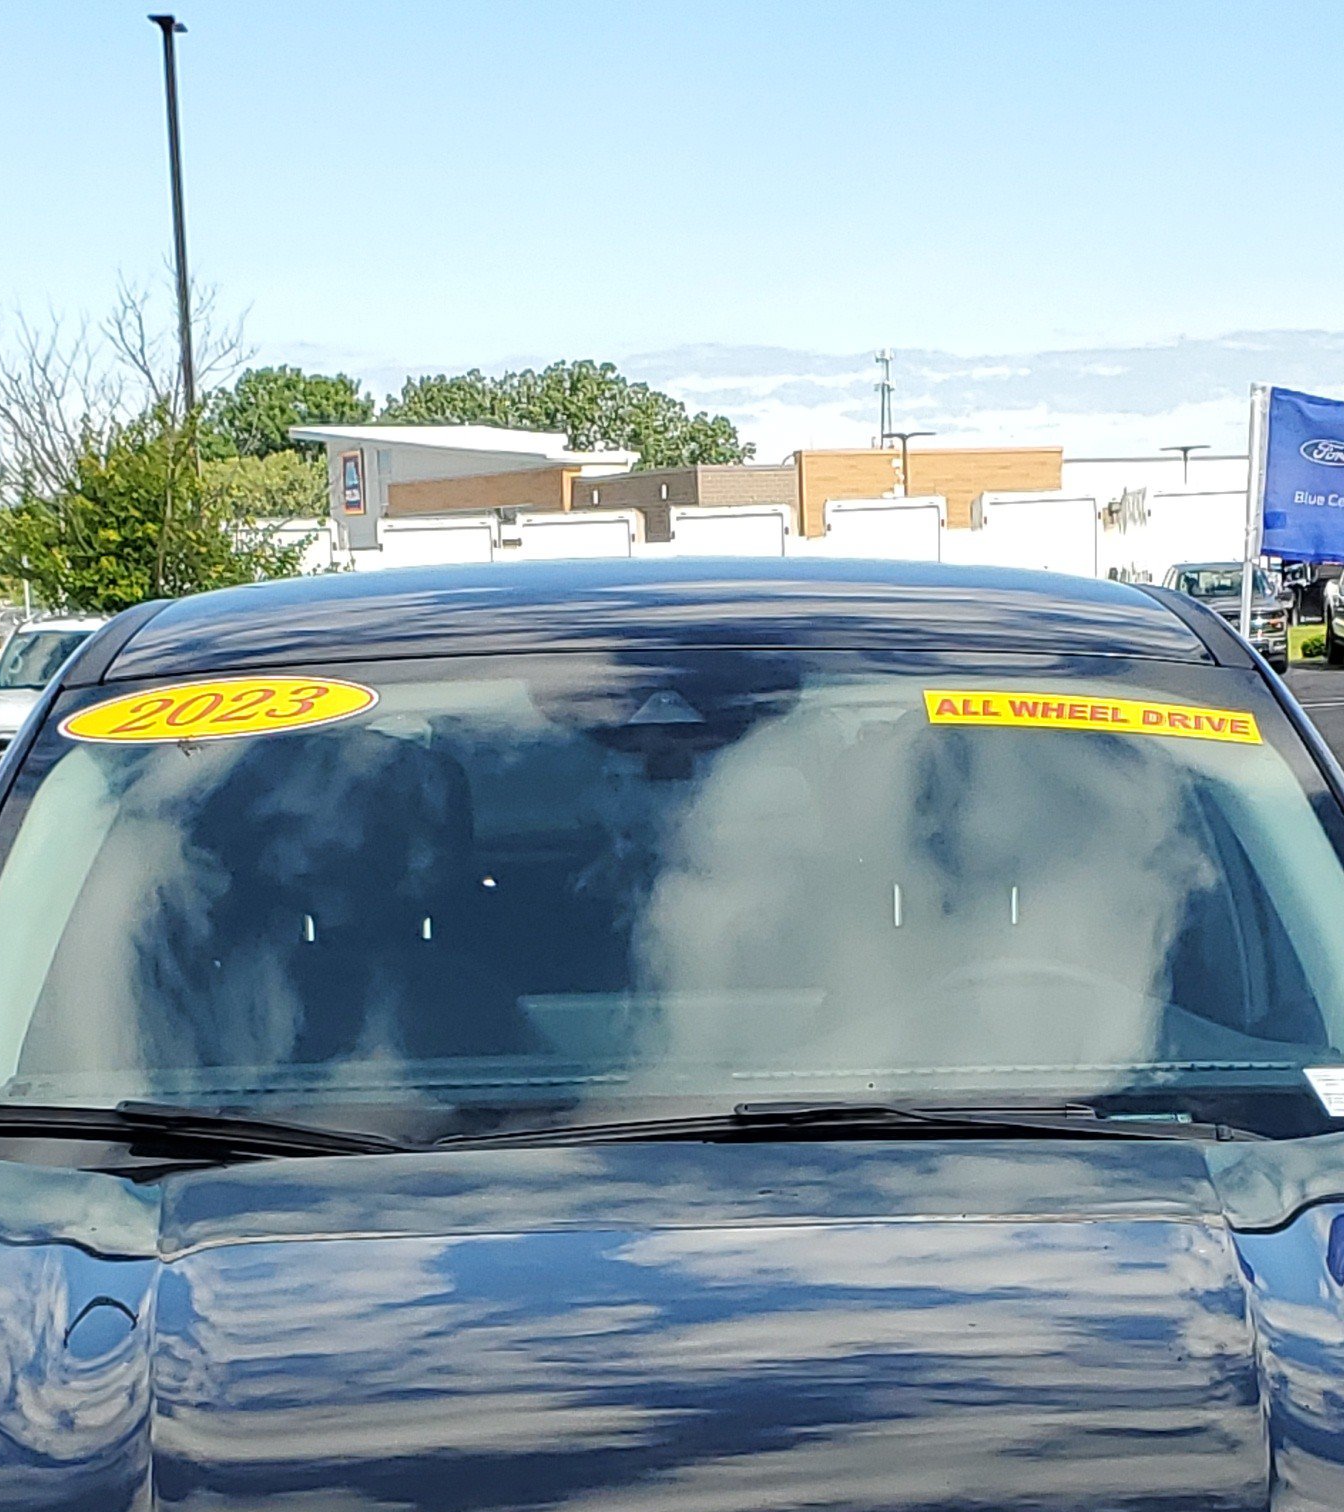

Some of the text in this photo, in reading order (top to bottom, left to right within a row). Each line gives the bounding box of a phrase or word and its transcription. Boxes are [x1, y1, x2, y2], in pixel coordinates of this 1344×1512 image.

[1294, 491, 1325, 506] Blue
[109, 686, 330, 734] 2023
[935, 698, 1251, 735] ALL WHEEL DRIVE
